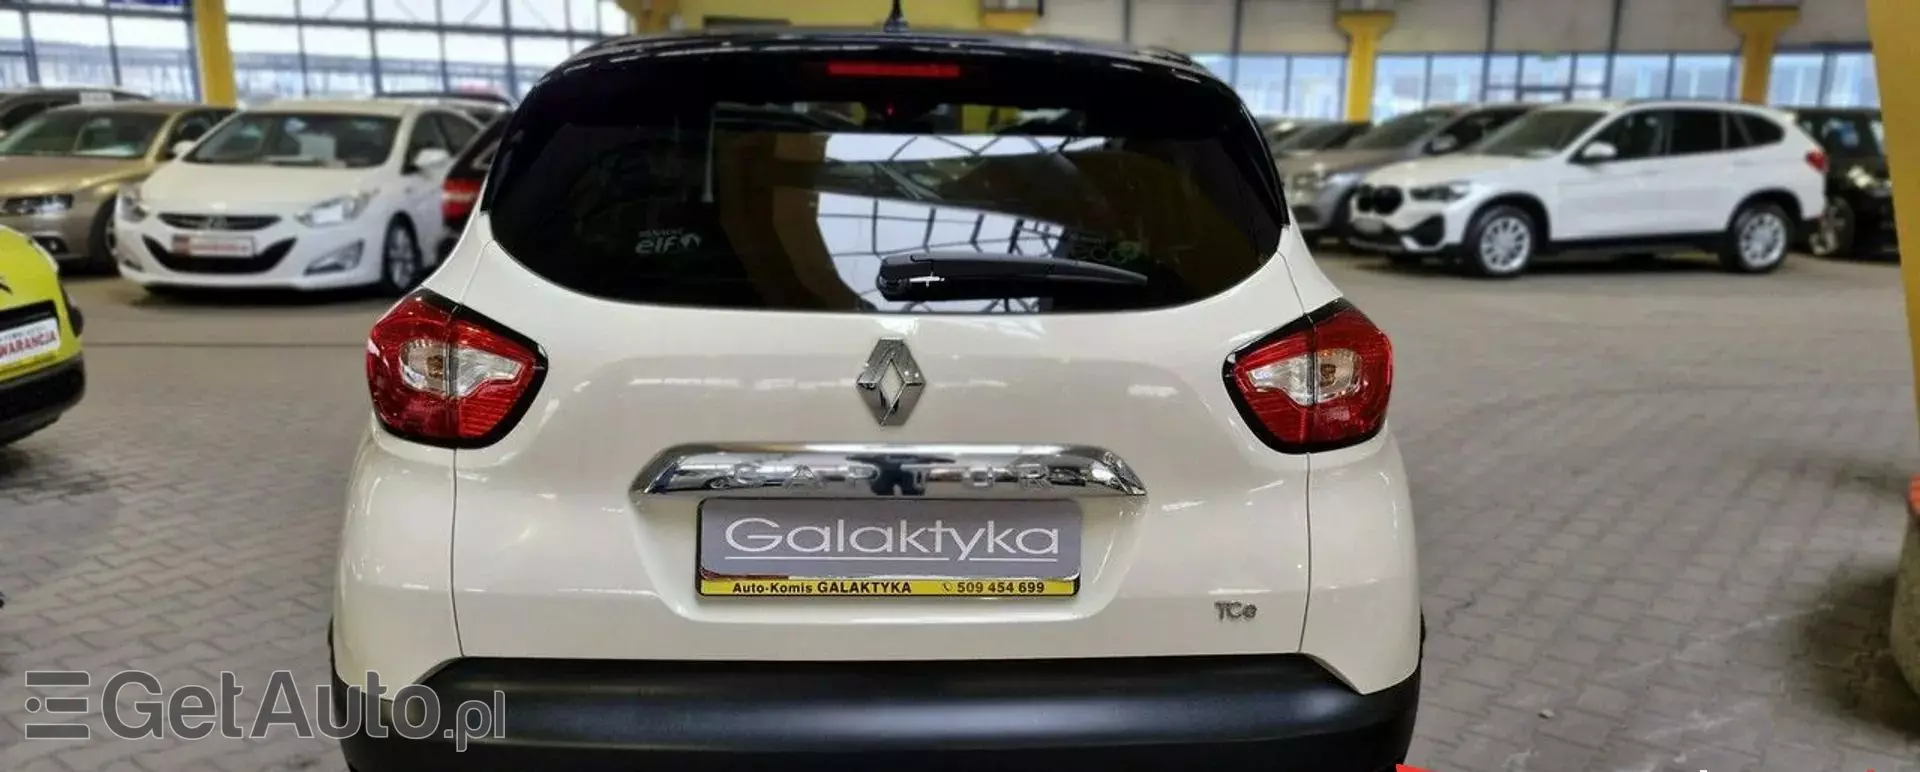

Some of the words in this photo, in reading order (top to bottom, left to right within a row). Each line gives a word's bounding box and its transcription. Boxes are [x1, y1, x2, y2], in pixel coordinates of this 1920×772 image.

[734, 461, 1055, 492] CAPTUR
[724, 516, 1059, 561] Galaktyka
[732, 581, 813, 594] Auto-Komis
[817, 581, 912, 594] GALAKTYKA
[957, 582, 984, 594] 509
[987, 582, 1015, 594] 454
[1018, 582, 1045, 594] 699
